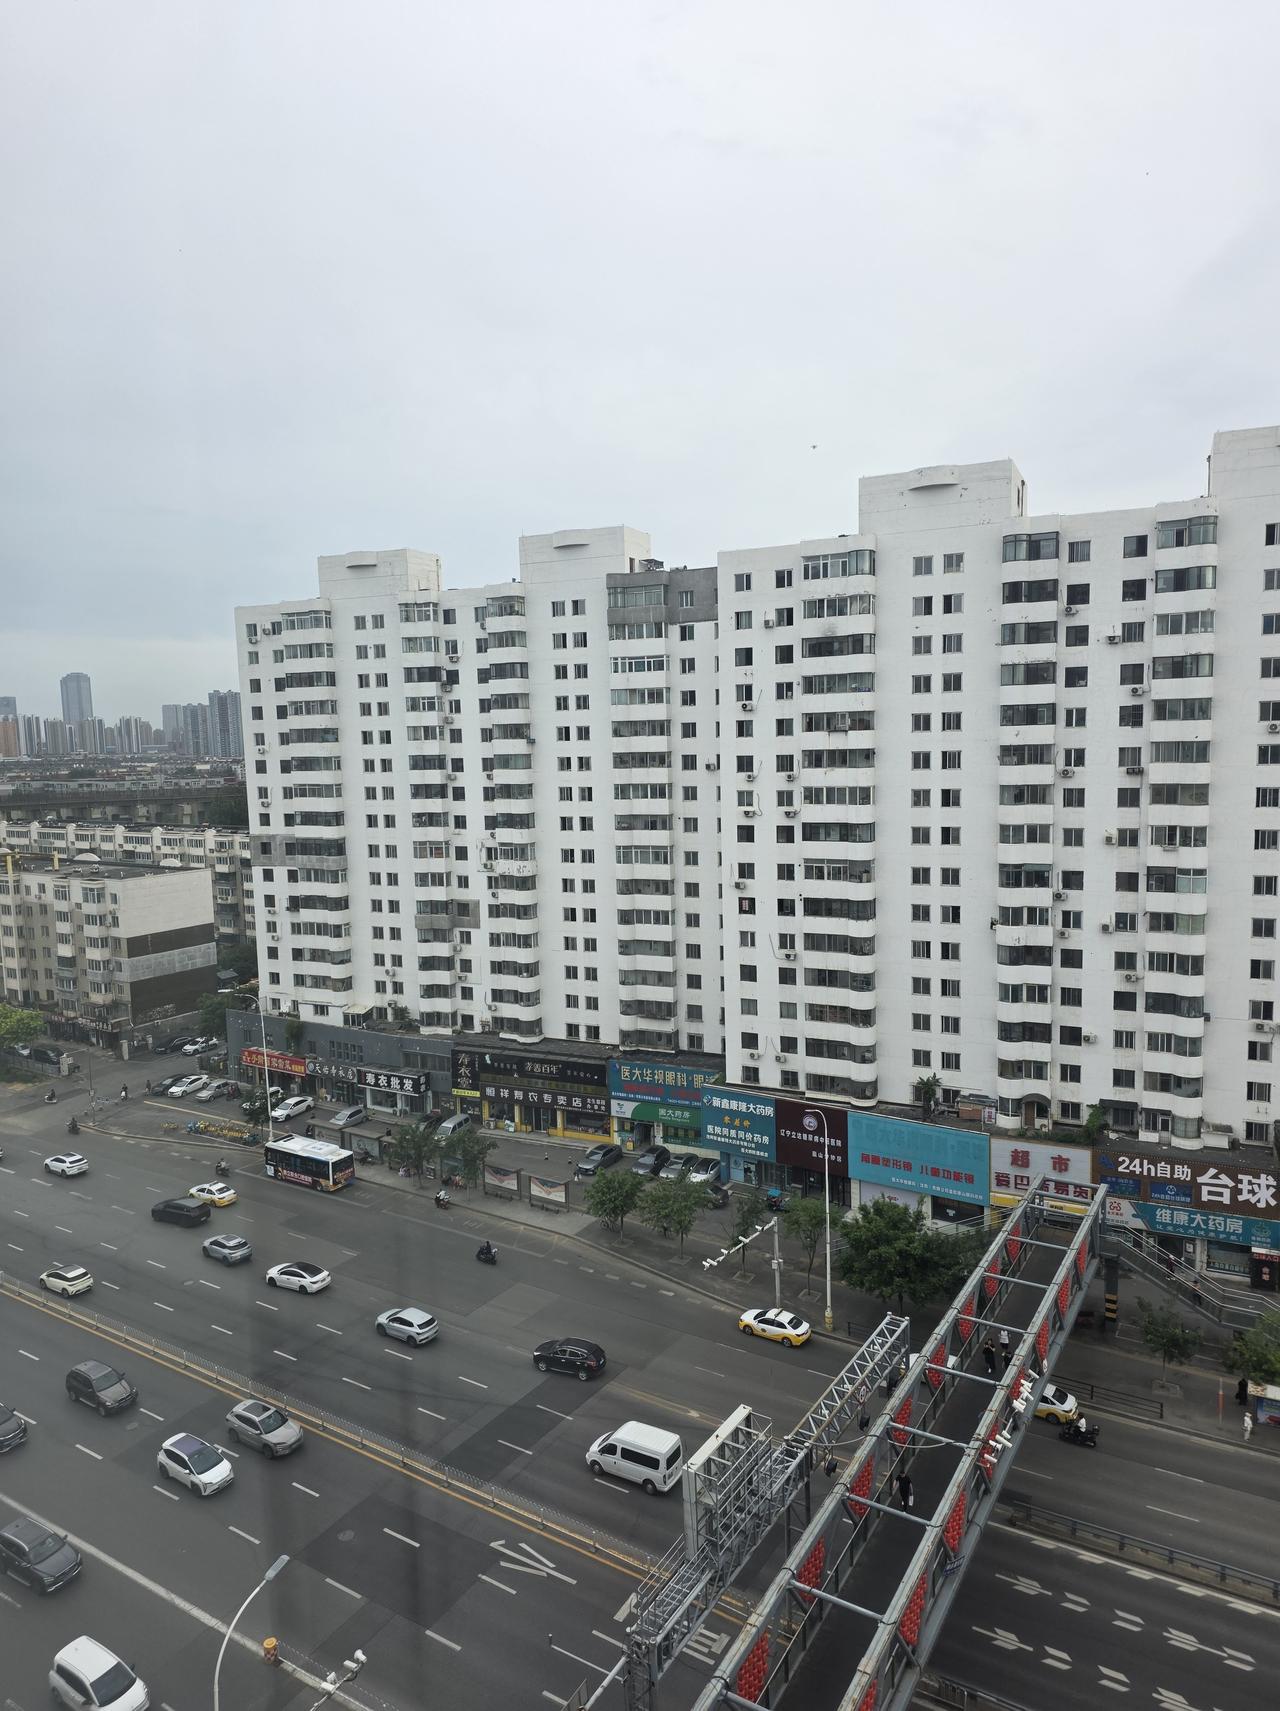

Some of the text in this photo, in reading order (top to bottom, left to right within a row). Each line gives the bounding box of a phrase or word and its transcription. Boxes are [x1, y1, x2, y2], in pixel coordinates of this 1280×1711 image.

[365, 1072, 414, 1092] 寿衣批发
[712, 1096, 774, 1117] 新鑫康隆大药房
[706, 1124, 769, 1145] 医院同质同价药房
[1010, 1148, 1070, 1173] 超市
[1117, 1156, 1279, 1208] 24h自助 台球
[1155, 1208, 1243, 1234] 维康大药房
